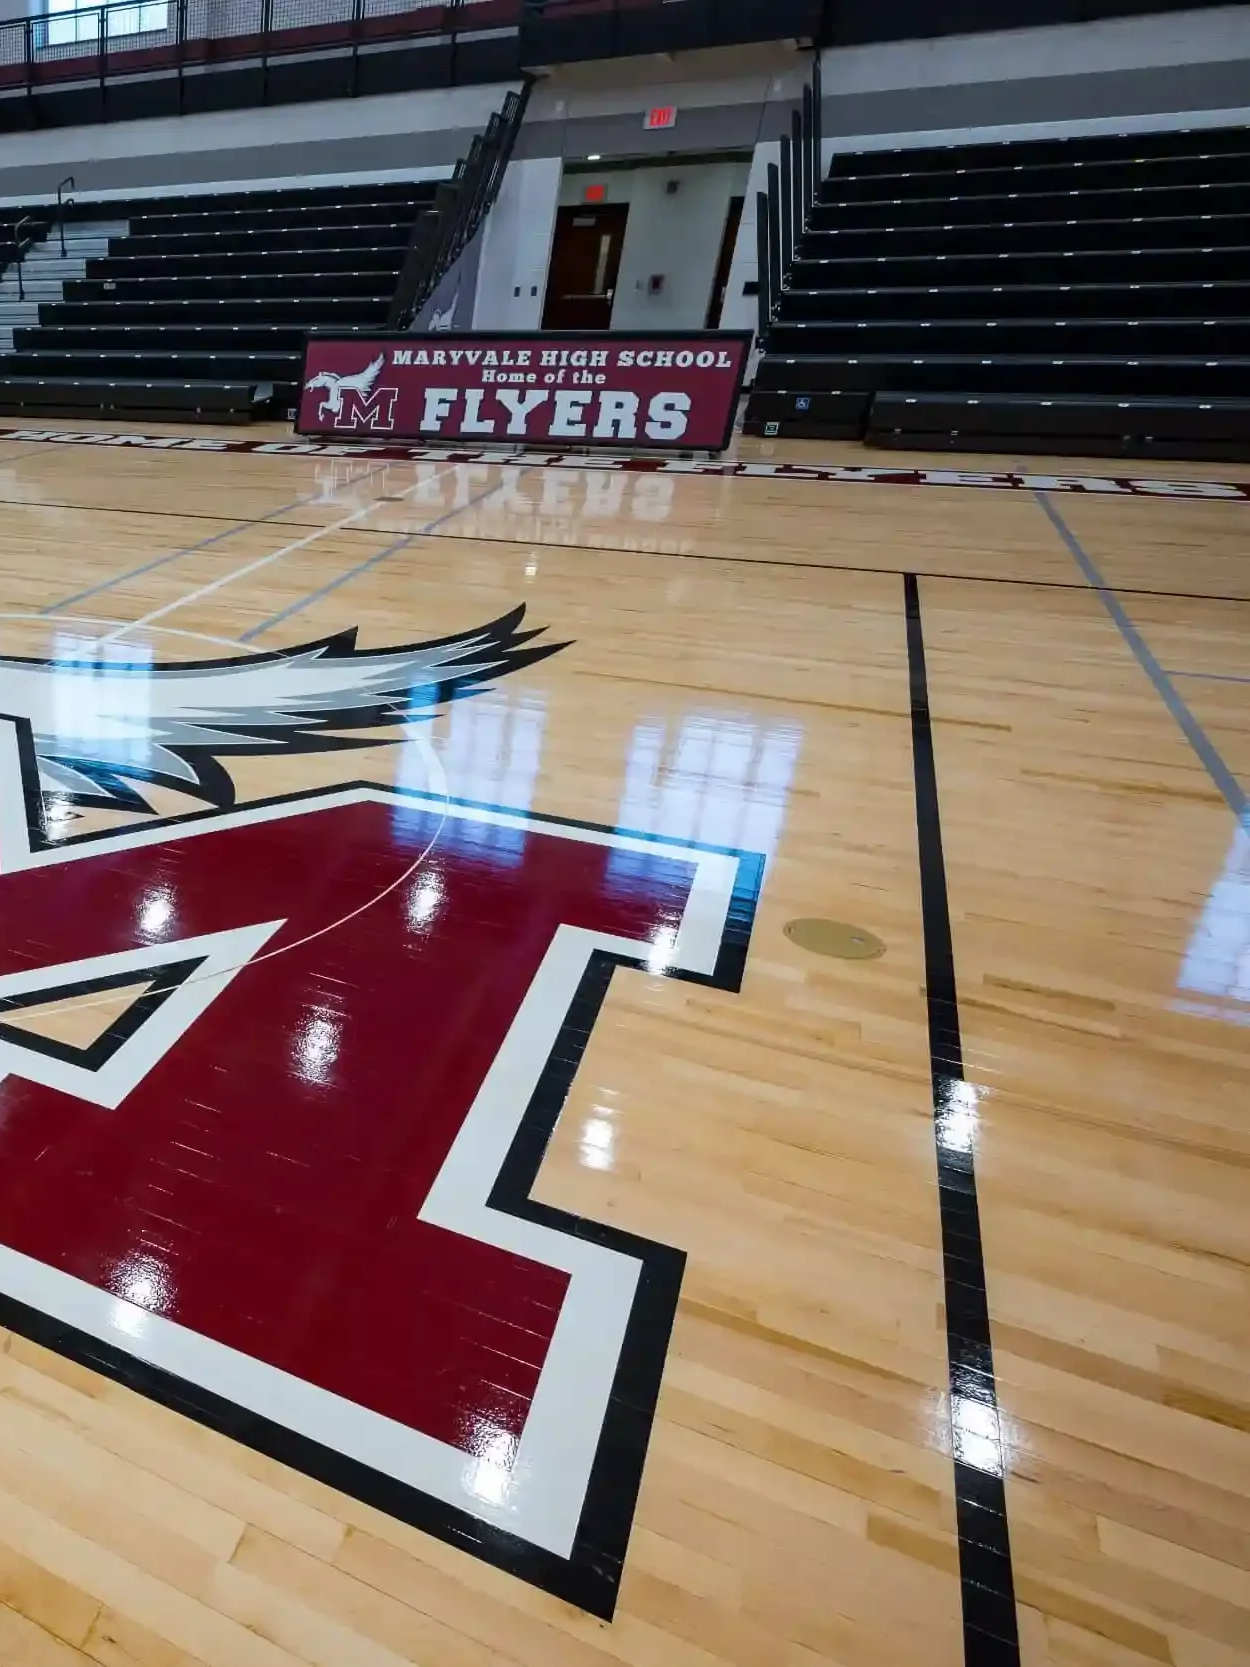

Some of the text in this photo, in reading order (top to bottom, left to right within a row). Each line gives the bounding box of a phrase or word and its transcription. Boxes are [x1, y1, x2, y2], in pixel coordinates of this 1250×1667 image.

[392, 350, 732, 368] MARYVALE HIGH SCHOOL
[481, 369, 607, 384] Home of the
[334, 387, 399, 430] M
[419, 388, 692, 440] FLYERS
[250, 442, 387, 457] OF
[407, 448, 632, 469] THE
[654, 459, 1249, 498] FLYERS
